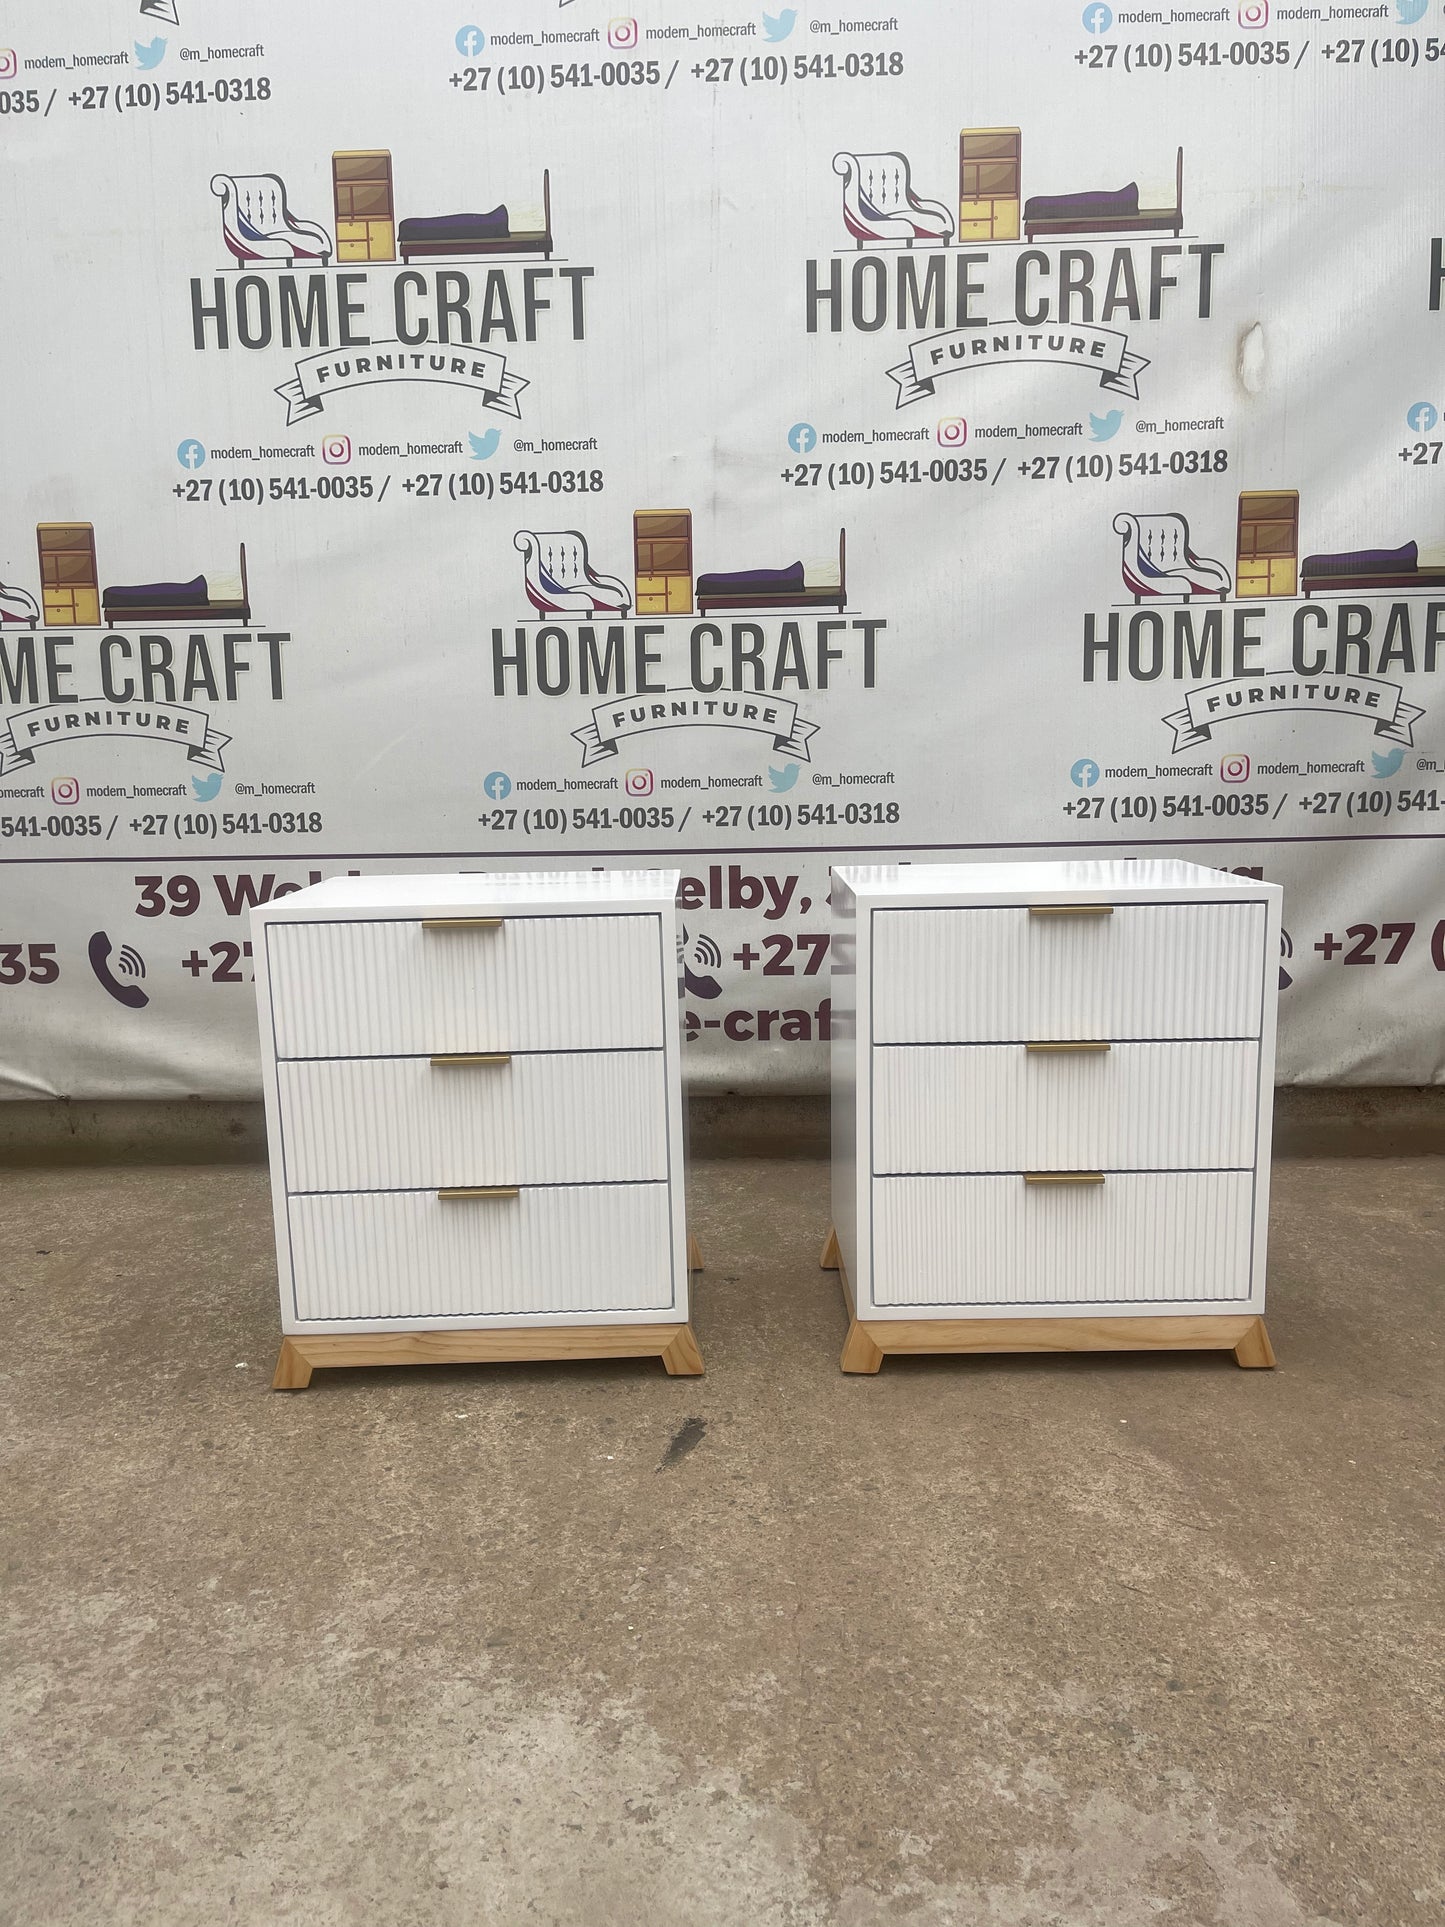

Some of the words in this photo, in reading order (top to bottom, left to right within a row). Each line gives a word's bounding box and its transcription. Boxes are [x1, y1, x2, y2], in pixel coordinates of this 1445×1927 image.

[810, 17, 898, 35] @m_homecraft
[180, 44, 264, 62] @m_homecraft
[1178, 41, 1289, 66] 541-0035
[551, 61, 660, 88] 541-0035
[794, 52, 903, 79] 541-0318
[166, 77, 271, 104] 541-0318
[805, 252, 989, 334] HOME
[1015, 244, 1225, 326] CRAFT
[190, 273, 371, 350] HOME
[394, 267, 595, 346] CRAFT
[930, 334, 1107, 366] FURNITURE
[316, 354, 487, 384] FURNITURE
[1136, 417, 1224, 434] @m_homecraft
[514, 438, 597, 453] @m_homecraft
[1399, 442, 1443, 465] +27
[880, 459, 987, 483] 541-0035
[1119, 449, 1227, 476] 541-0318
[270, 476, 373, 499] 541-0035
[500, 470, 603, 494] 541-0318
[1083, 608, 1266, 682] HOME
[1292, 602, 1445, 676] CRAF
[0, 637, 79, 704] ME
[100, 633, 291, 703] CRAFT
[491, 625, 666, 696] HOME
[690, 619, 887, 693] CRAFT
[1207, 684, 1381, 713] FURNITURE
[27, 711, 190, 737] FURNITURE
[612, 700, 779, 729] FURNITURE
[813, 772, 895, 787] @m_homecraft
[1417, 759, 1445, 772] @m_
[235, 782, 315, 796] @m_homecraft
[573, 807, 674, 829] 541-0035
[798, 802, 899, 825] 541-0318
[1163, 794, 1268, 817] 541-0035
[223, 812, 322, 834] 541-0318
[135, 875, 200, 917] 39
[647, 866, 812, 920] elby,
[733, 934, 830, 976] +27
[1314, 922, 1416, 966] +27
[0, 943, 59, 984] 35
